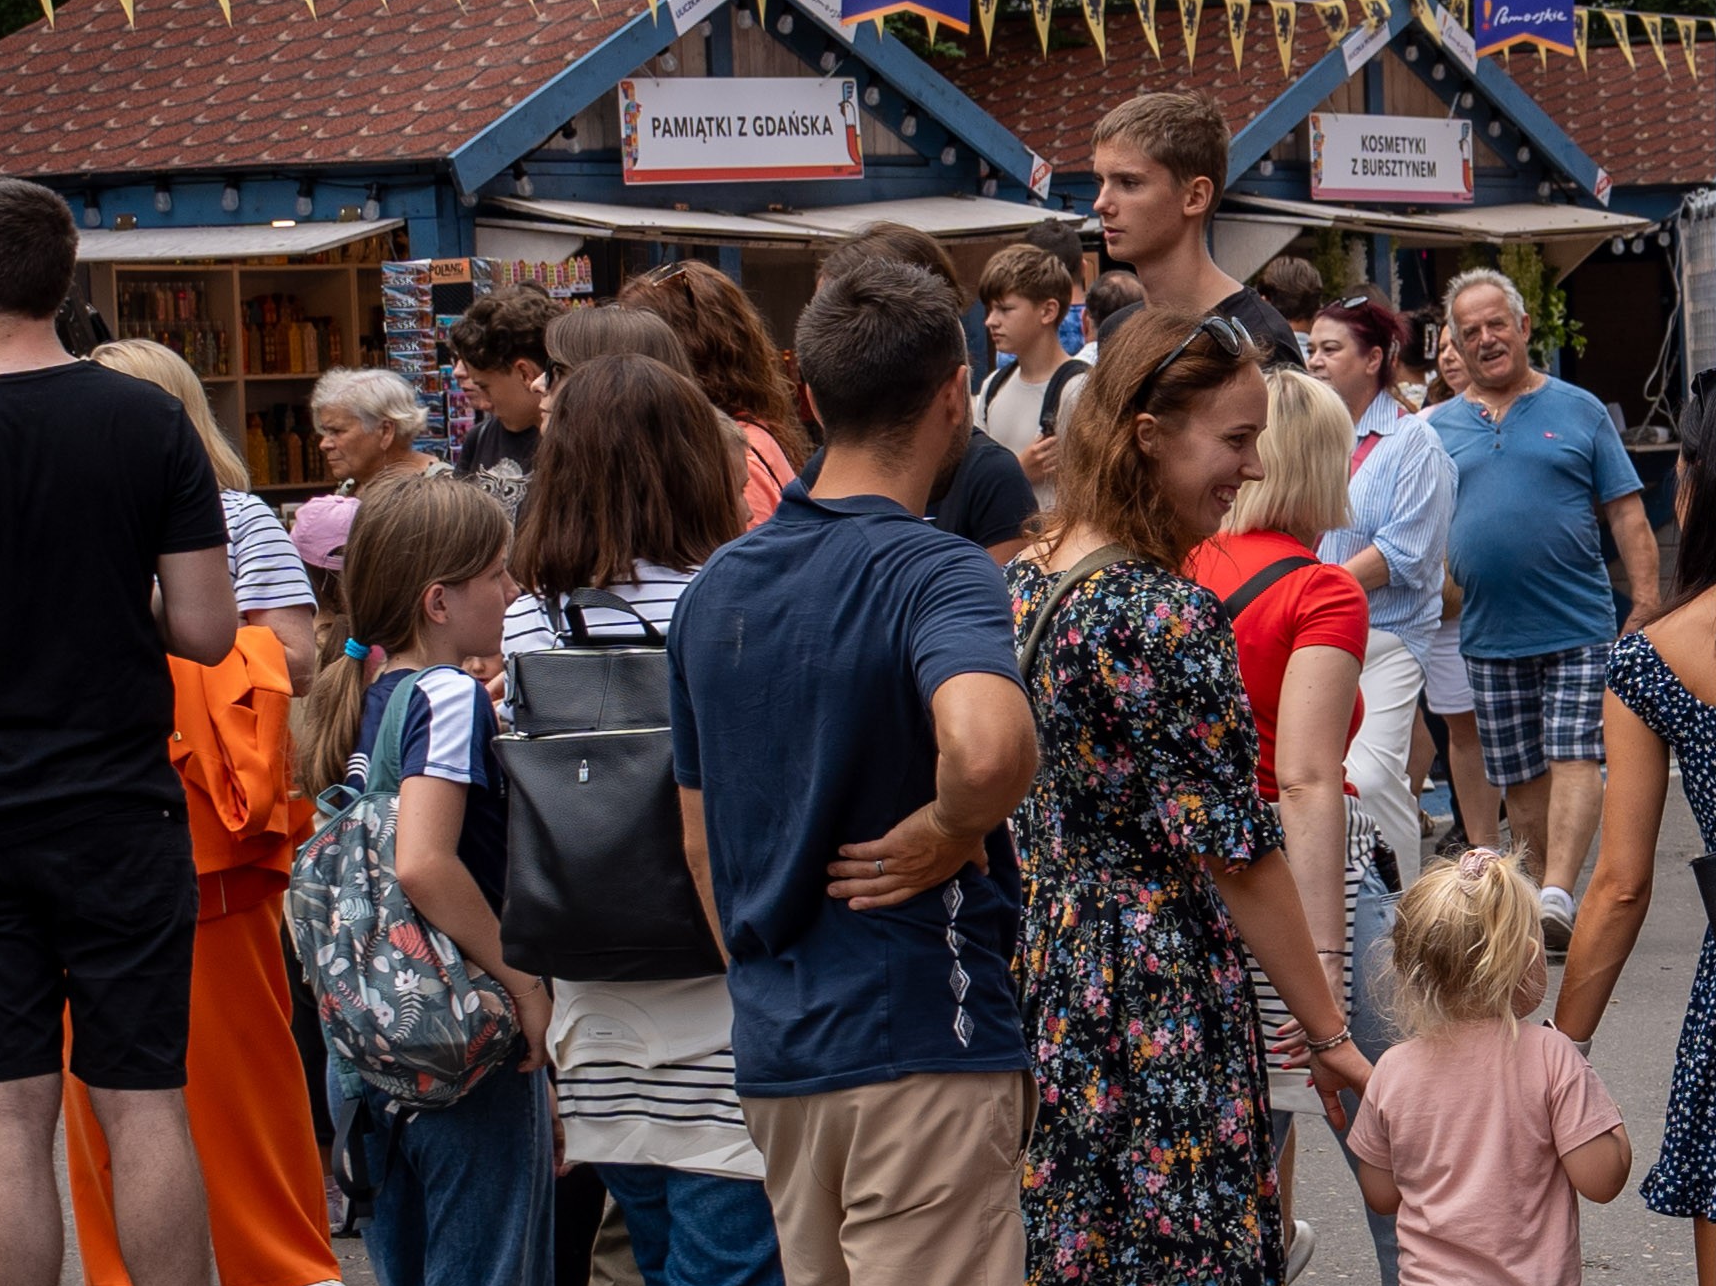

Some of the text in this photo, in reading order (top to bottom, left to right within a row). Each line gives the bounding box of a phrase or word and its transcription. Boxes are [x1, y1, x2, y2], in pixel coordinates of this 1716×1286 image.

[1493, 5, 1568, 27] Pomorskie
[651, 110, 834, 144] PAMIĄTKI Z GDAŃSKA
[1361, 134, 1427, 156] KOSMETYKI
[1351, 158, 1437, 178] Z BURSZTYNEM
